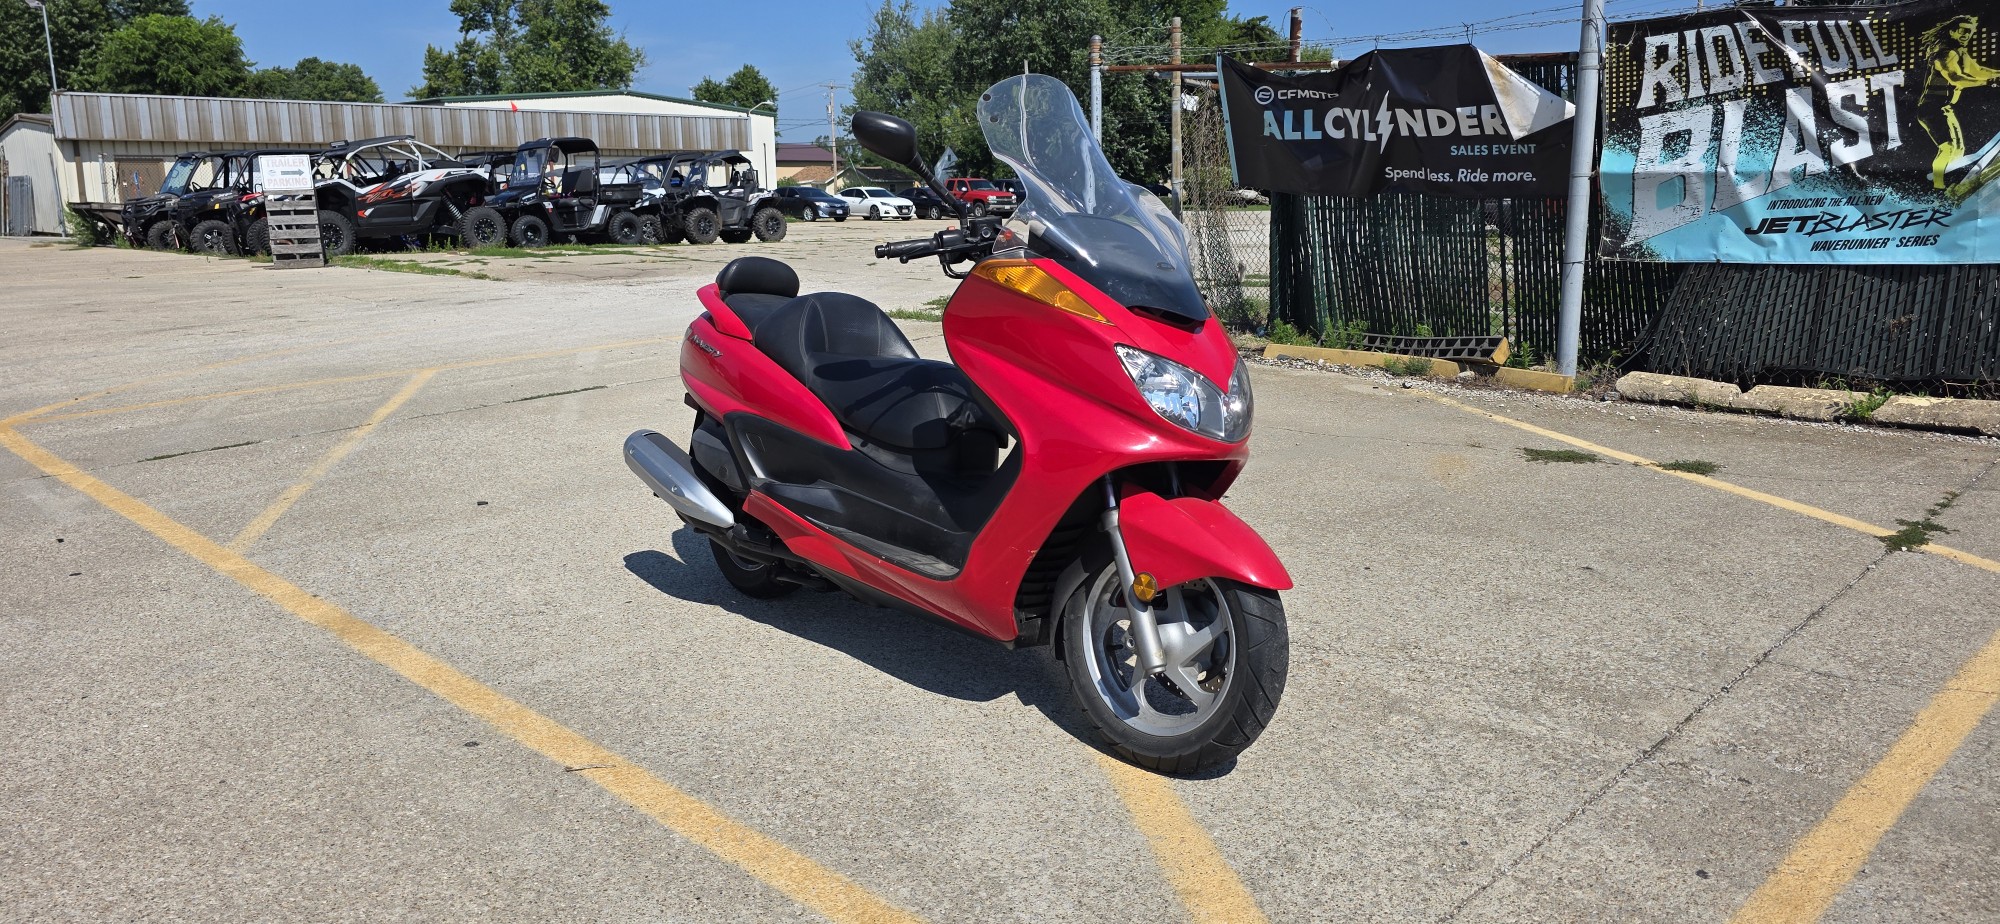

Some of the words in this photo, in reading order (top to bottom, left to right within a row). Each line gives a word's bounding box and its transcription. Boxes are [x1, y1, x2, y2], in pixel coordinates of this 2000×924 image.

[1636, 20, 1785, 109] RIDE
[1777, 20, 1899, 78] FULL
[1450, 144, 1489, 156] SALES
[1492, 143, 1537, 155] EVENT
[266, 158, 305, 168] TRAILER
[1622, 70, 1905, 248] BLAST
[267, 177, 308, 187] PARKING
[1385, 166, 1425, 182] Spend
[1427, 168, 1454, 183] less.
[1457, 168, 1489, 182] Ride
[1492, 170, 1537, 182] more.
[1766, 199, 1827, 211] INTRODUCING
[1829, 197, 1843, 207] THE
[1843, 195, 1886, 207] ALL-NEW
[1896, 234, 1940, 248] SERIES
